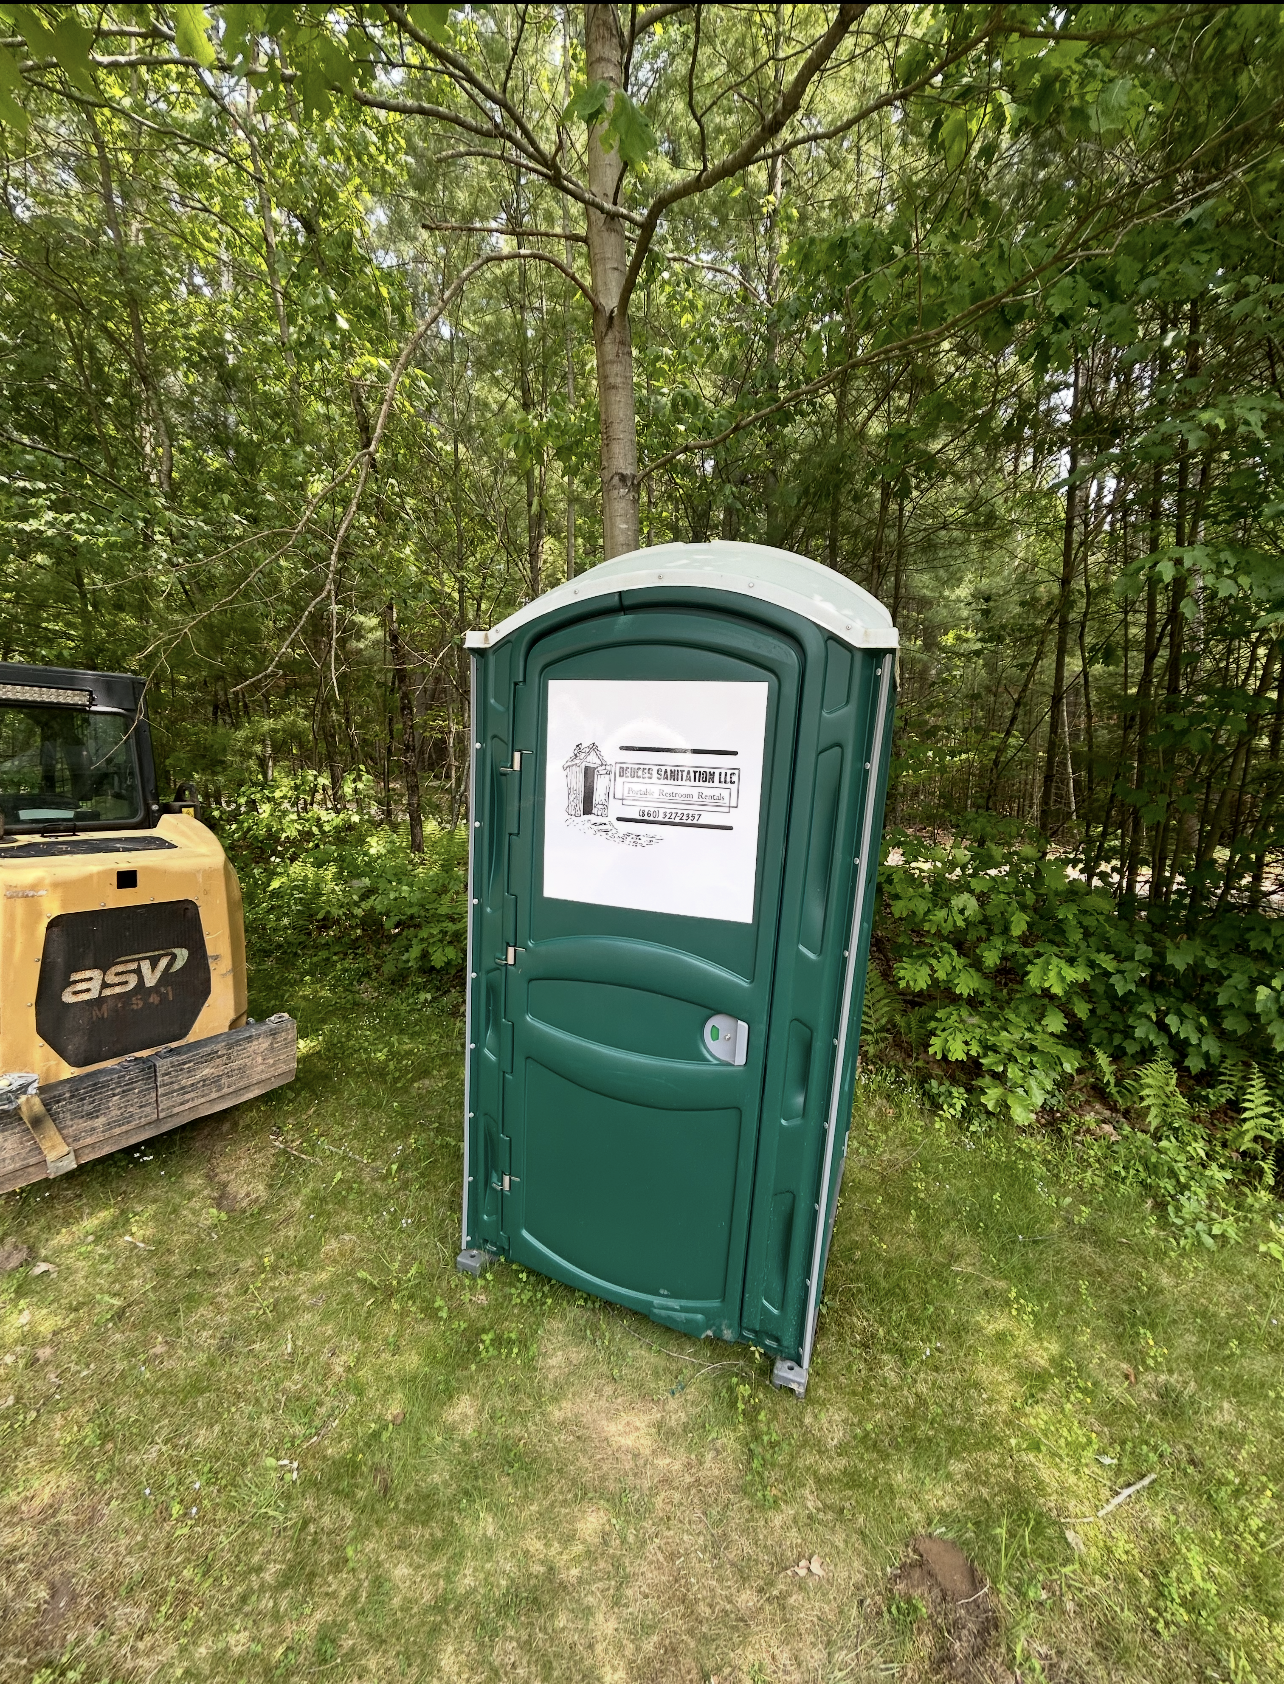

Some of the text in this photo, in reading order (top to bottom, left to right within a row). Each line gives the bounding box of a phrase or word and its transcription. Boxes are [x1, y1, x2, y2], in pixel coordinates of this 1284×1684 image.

[619, 766, 737, 785] DEUCES SANITATION LLC
[627, 786, 725, 801] Portable Restroom Rentals
[638, 808, 702, 822] (860) 327-2357
